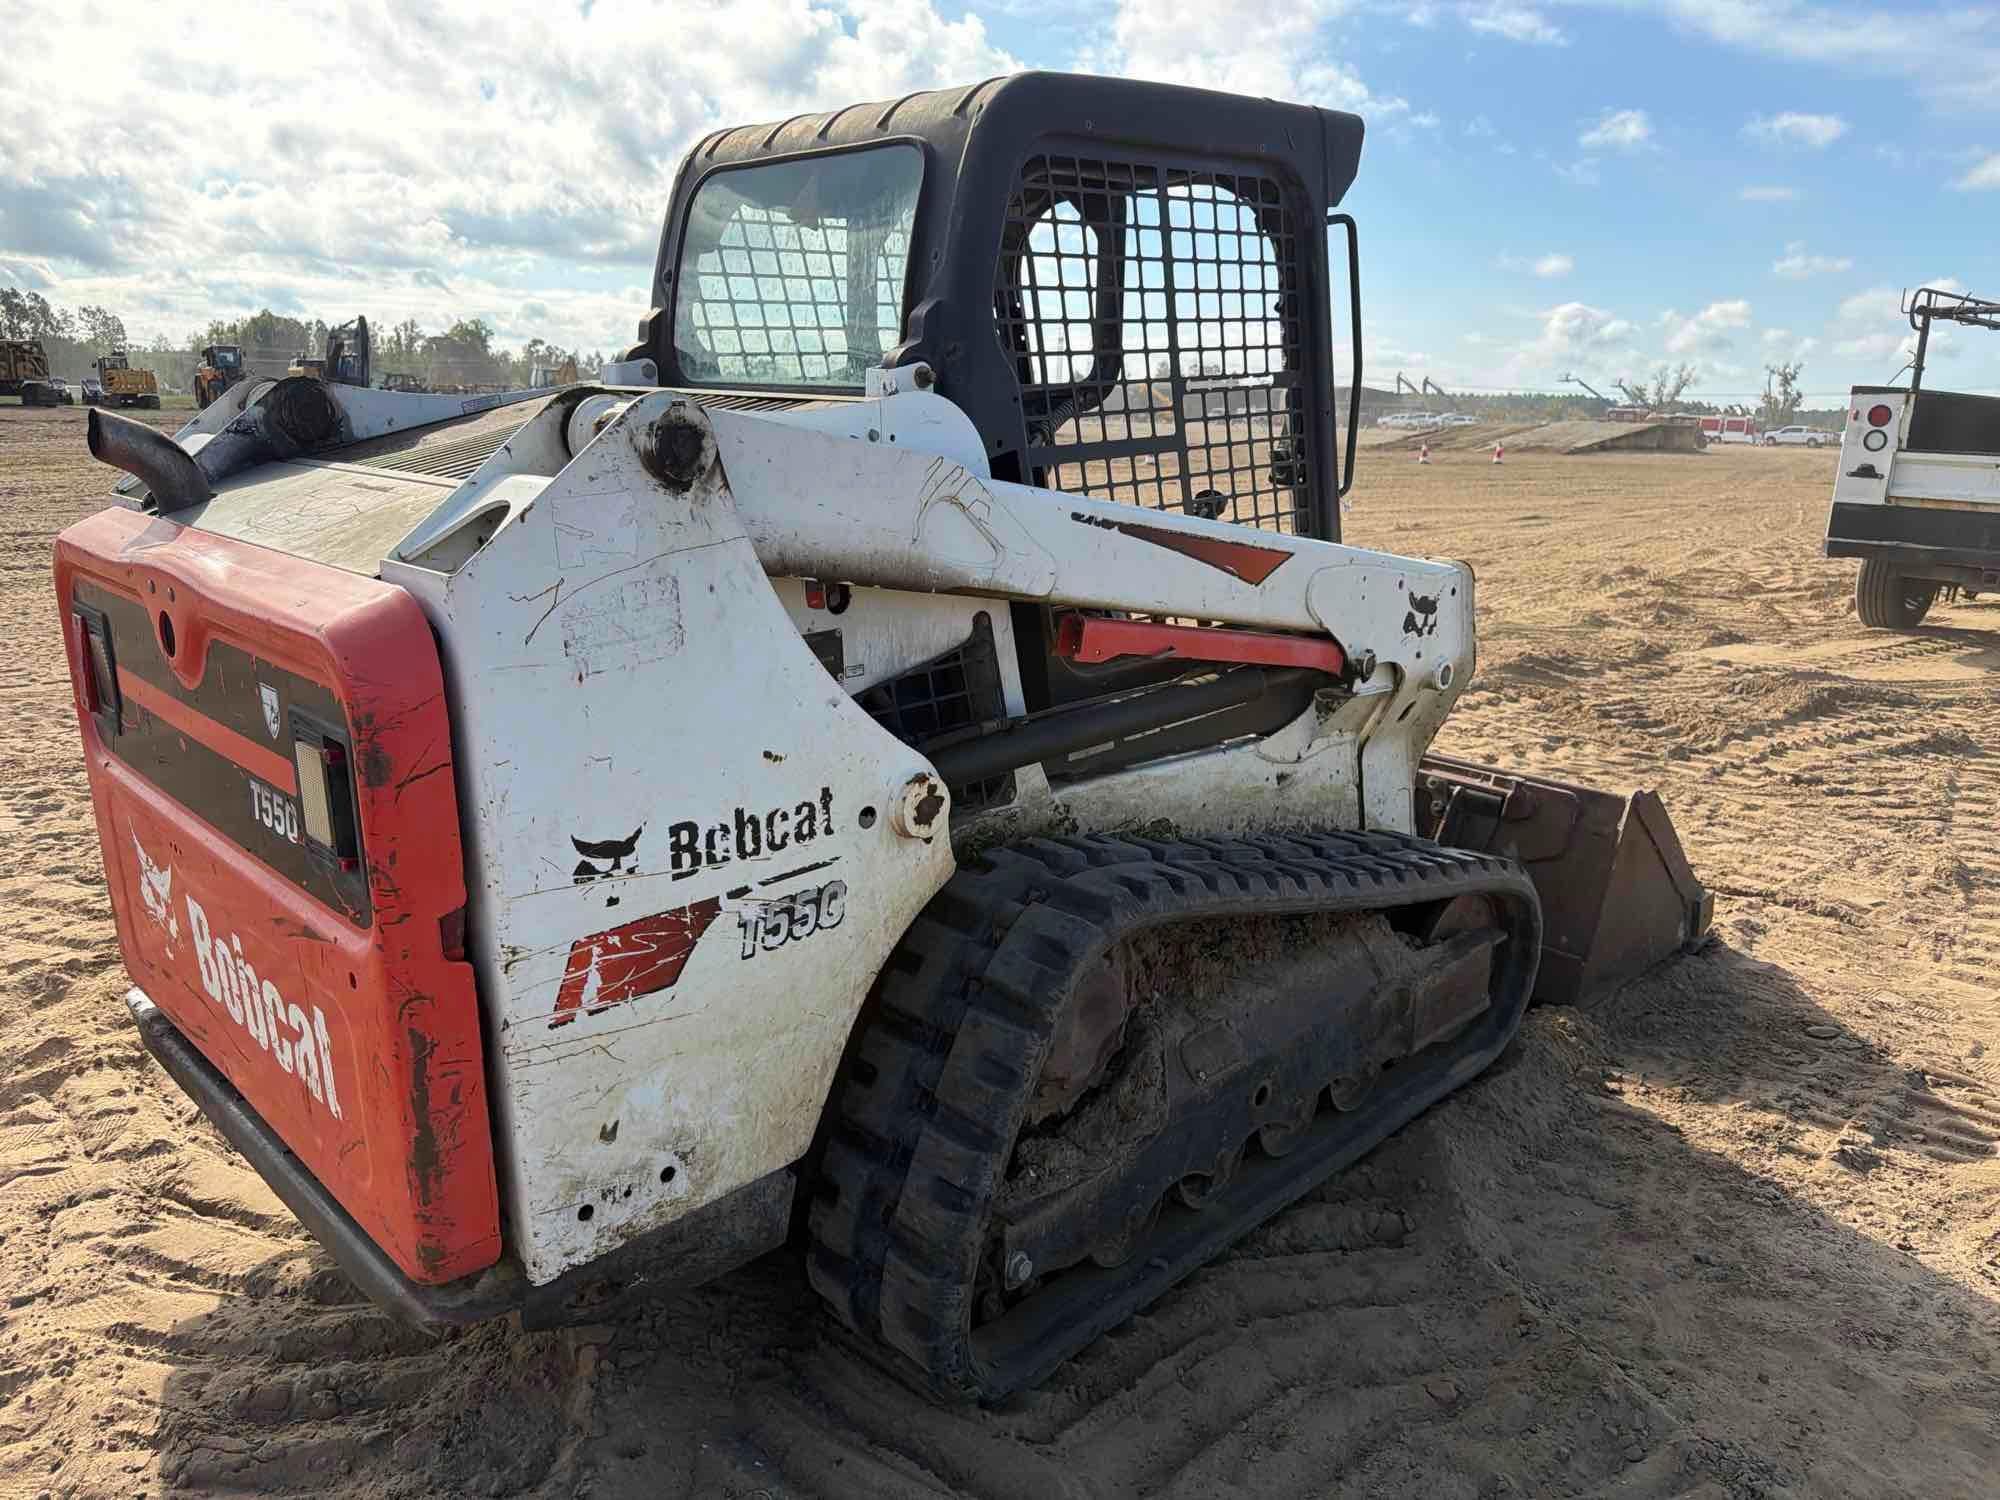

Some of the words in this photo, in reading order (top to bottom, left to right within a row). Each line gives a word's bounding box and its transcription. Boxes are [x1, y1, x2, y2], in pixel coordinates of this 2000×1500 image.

[249, 779, 299, 845] T550
[669, 786, 834, 881] Bobcat
[736, 880, 848, 960] T550
[186, 894, 343, 1120] Bobcat
